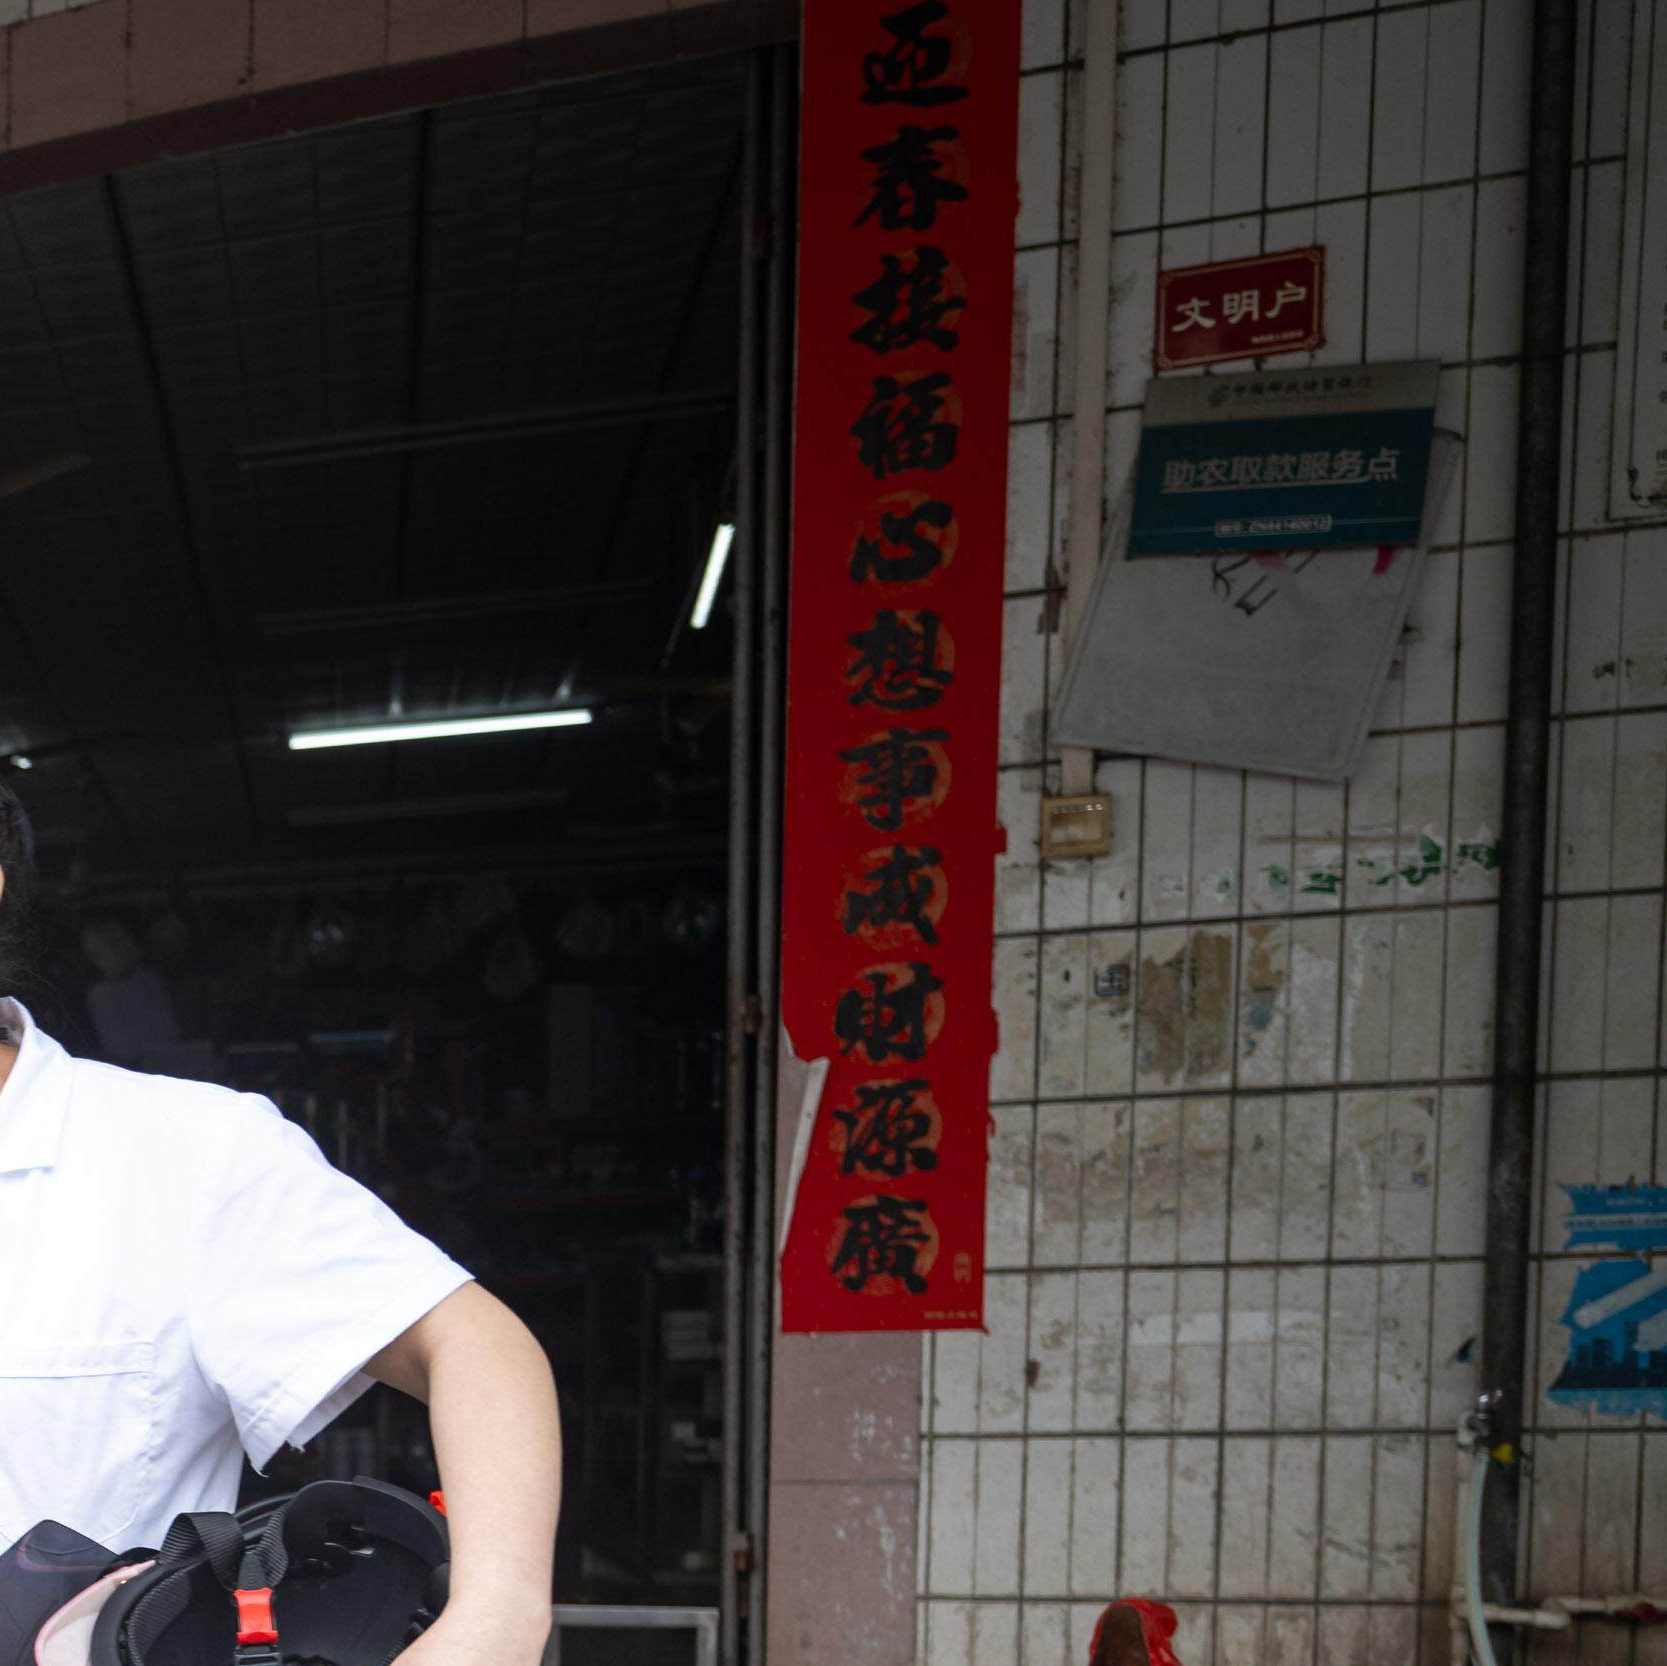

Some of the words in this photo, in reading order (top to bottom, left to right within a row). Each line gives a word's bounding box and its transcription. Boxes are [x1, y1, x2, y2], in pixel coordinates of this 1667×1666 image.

[1171, 281, 1308, 332] 文明户
[1163, 446, 1400, 486] 助农取款服务点
